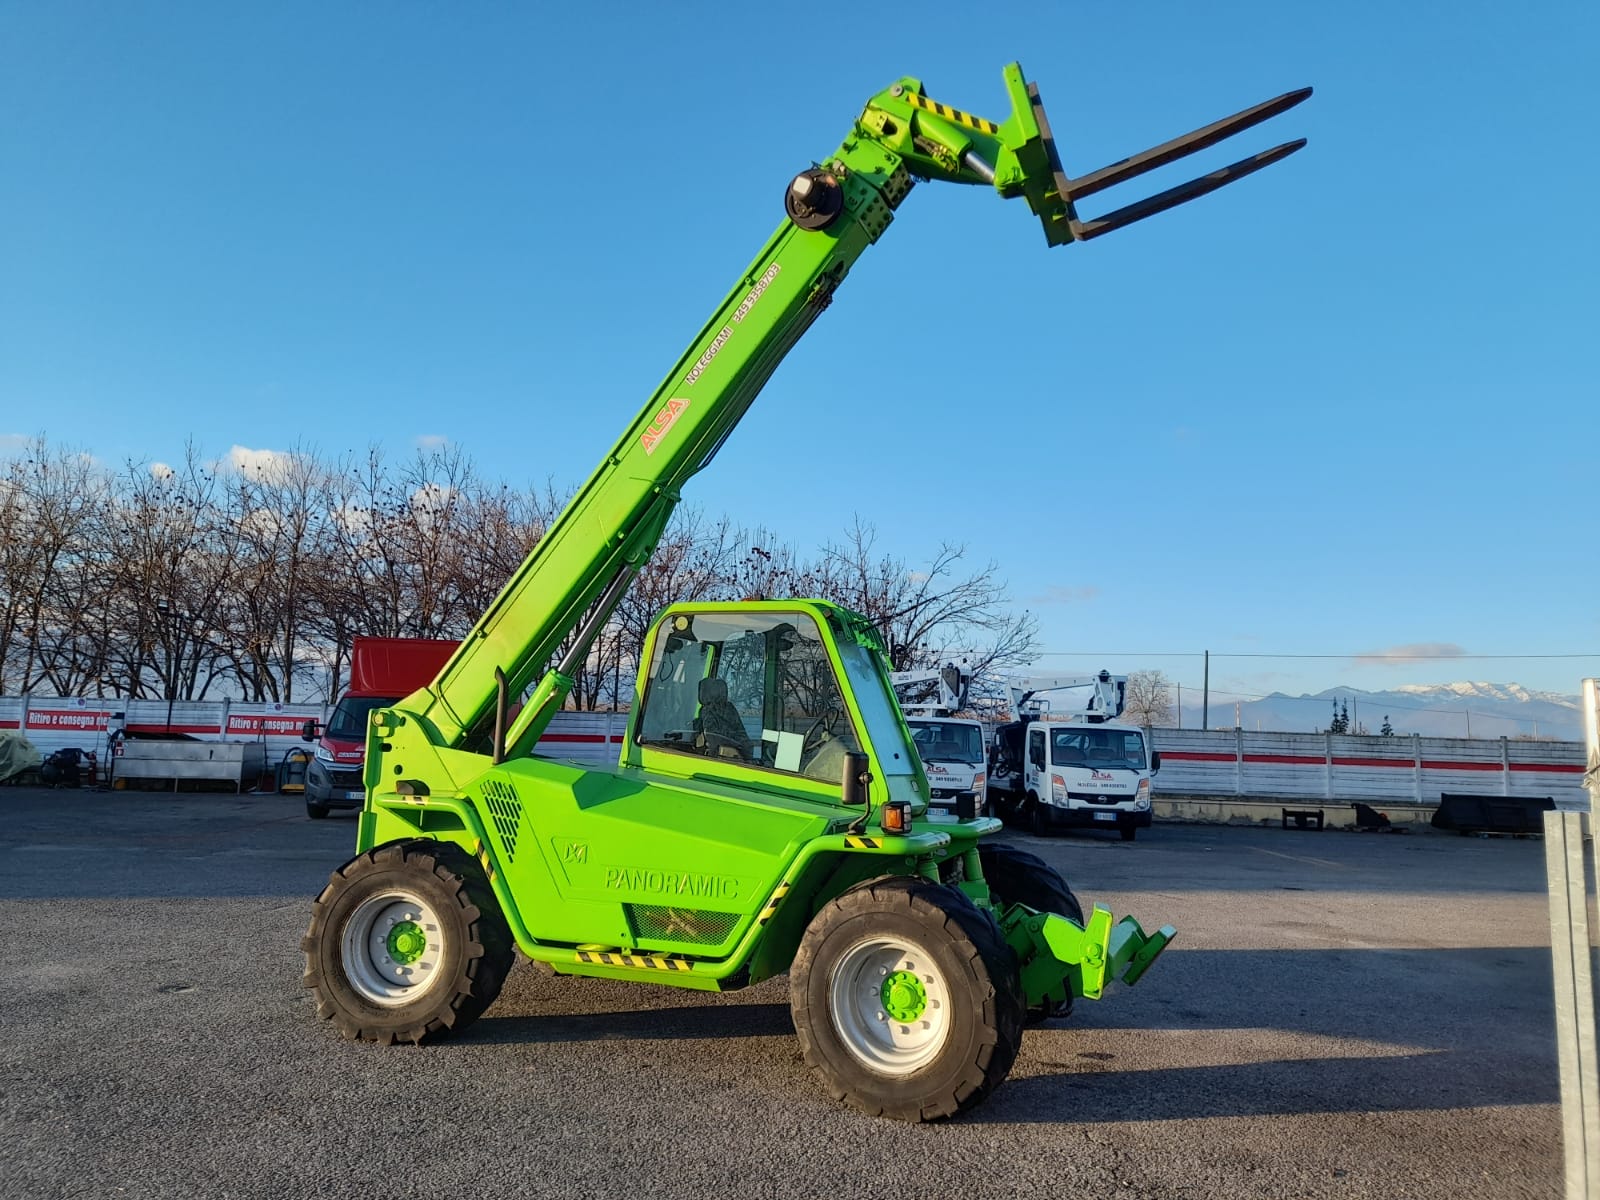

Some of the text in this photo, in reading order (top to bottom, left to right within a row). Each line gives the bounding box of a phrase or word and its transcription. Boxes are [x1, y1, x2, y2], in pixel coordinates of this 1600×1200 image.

[686, 263, 780, 383] NOLEGGIAMI 349 9358703
[641, 400, 683, 451] ALSA
[28, 711, 51, 724] Ritiro
[51, 714, 58, 725] e
[58, 714, 95, 729] consegna
[229, 716, 251, 729] Ritiro
[252, 719, 258, 730] e
[606, 866, 739, 900] PANORAMIC
